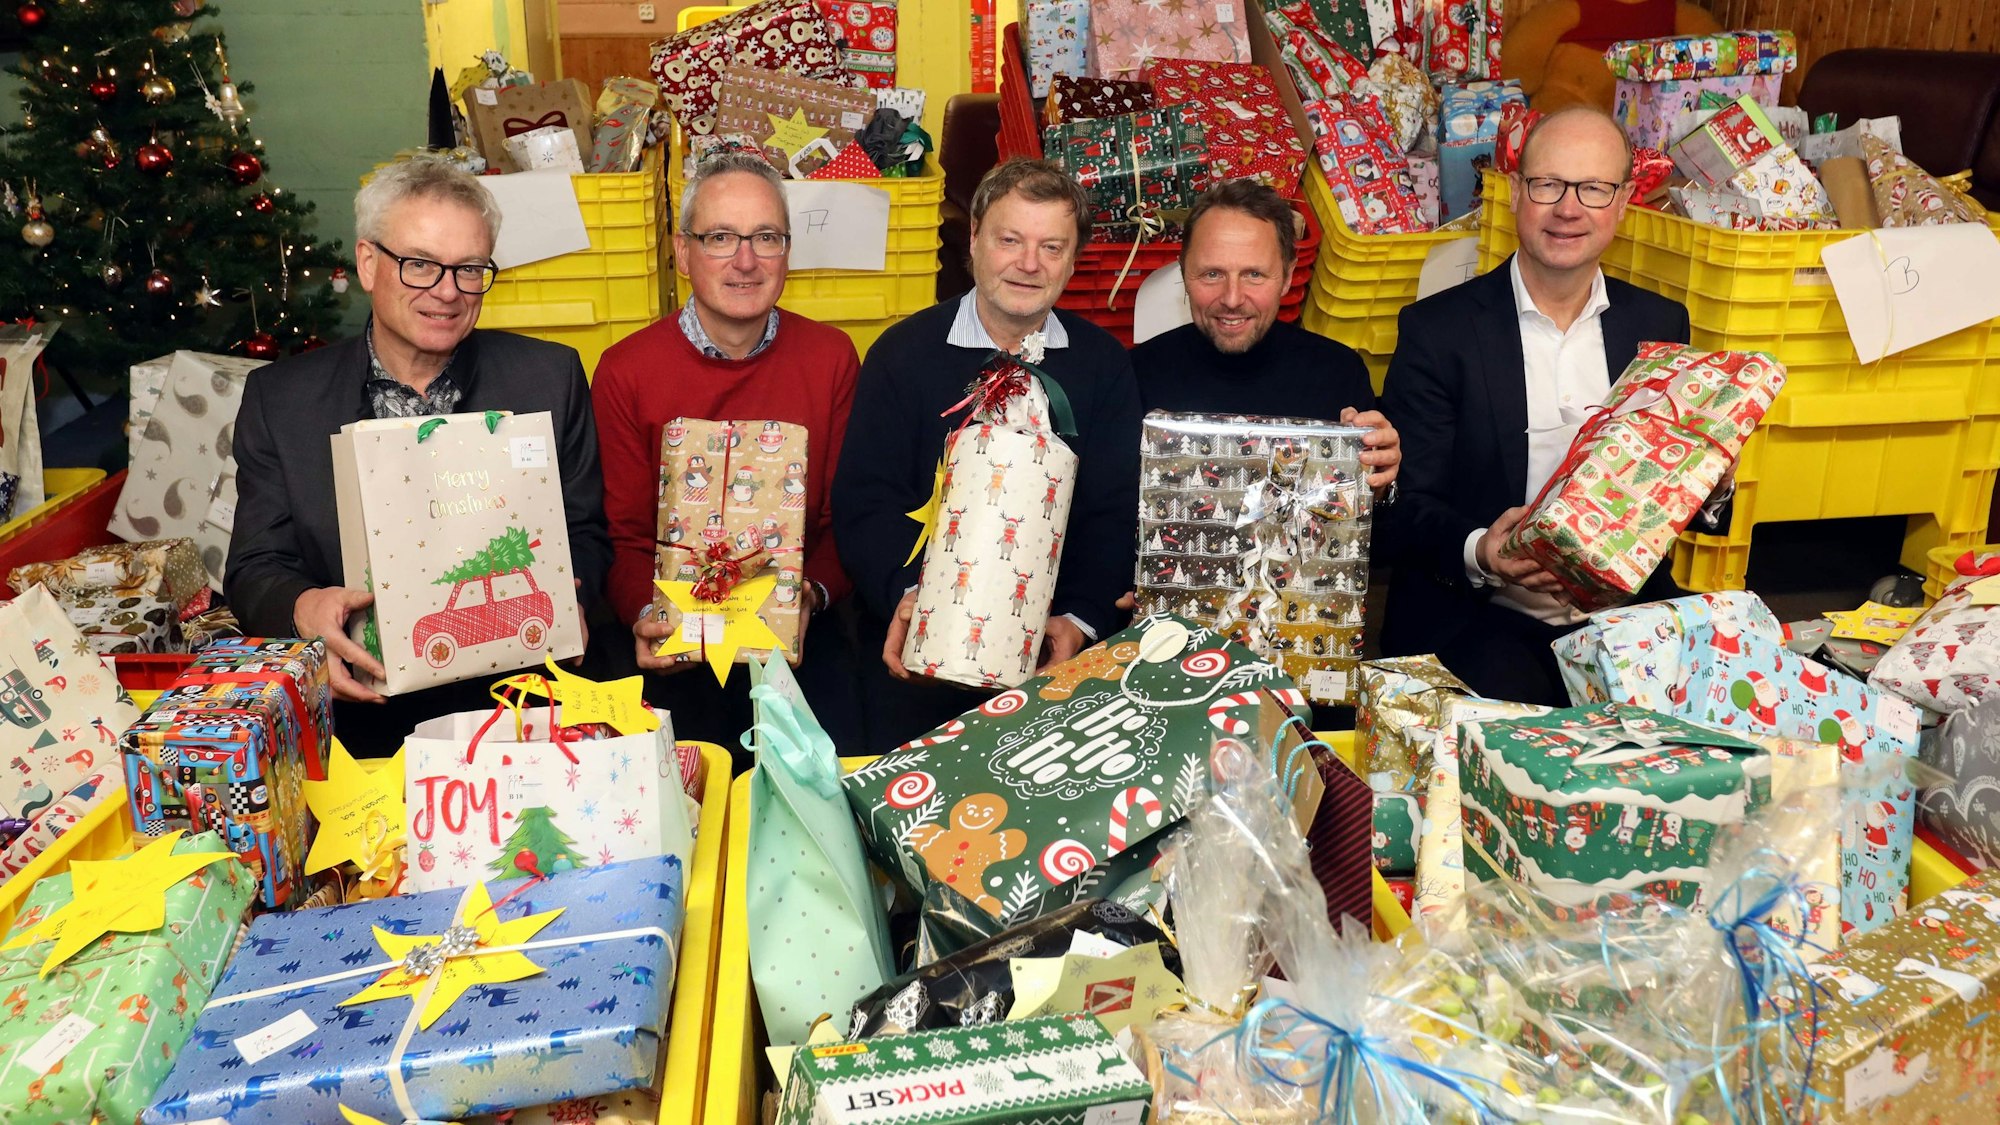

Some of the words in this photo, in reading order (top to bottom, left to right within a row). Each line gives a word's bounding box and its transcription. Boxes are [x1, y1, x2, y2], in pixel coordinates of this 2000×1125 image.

[1883, 255, 1920, 295] B
[433, 469, 490, 490] Merry
[428, 493, 507, 519] Christmas
[1706, 681, 1727, 703] HO
[1791, 703, 1804, 716] HO
[1844, 853, 1858, 867] HO
[1857, 866, 1877, 890] HO
[1873, 891, 1885, 904] HO
[845, 1079, 966, 1112] PACKSET
